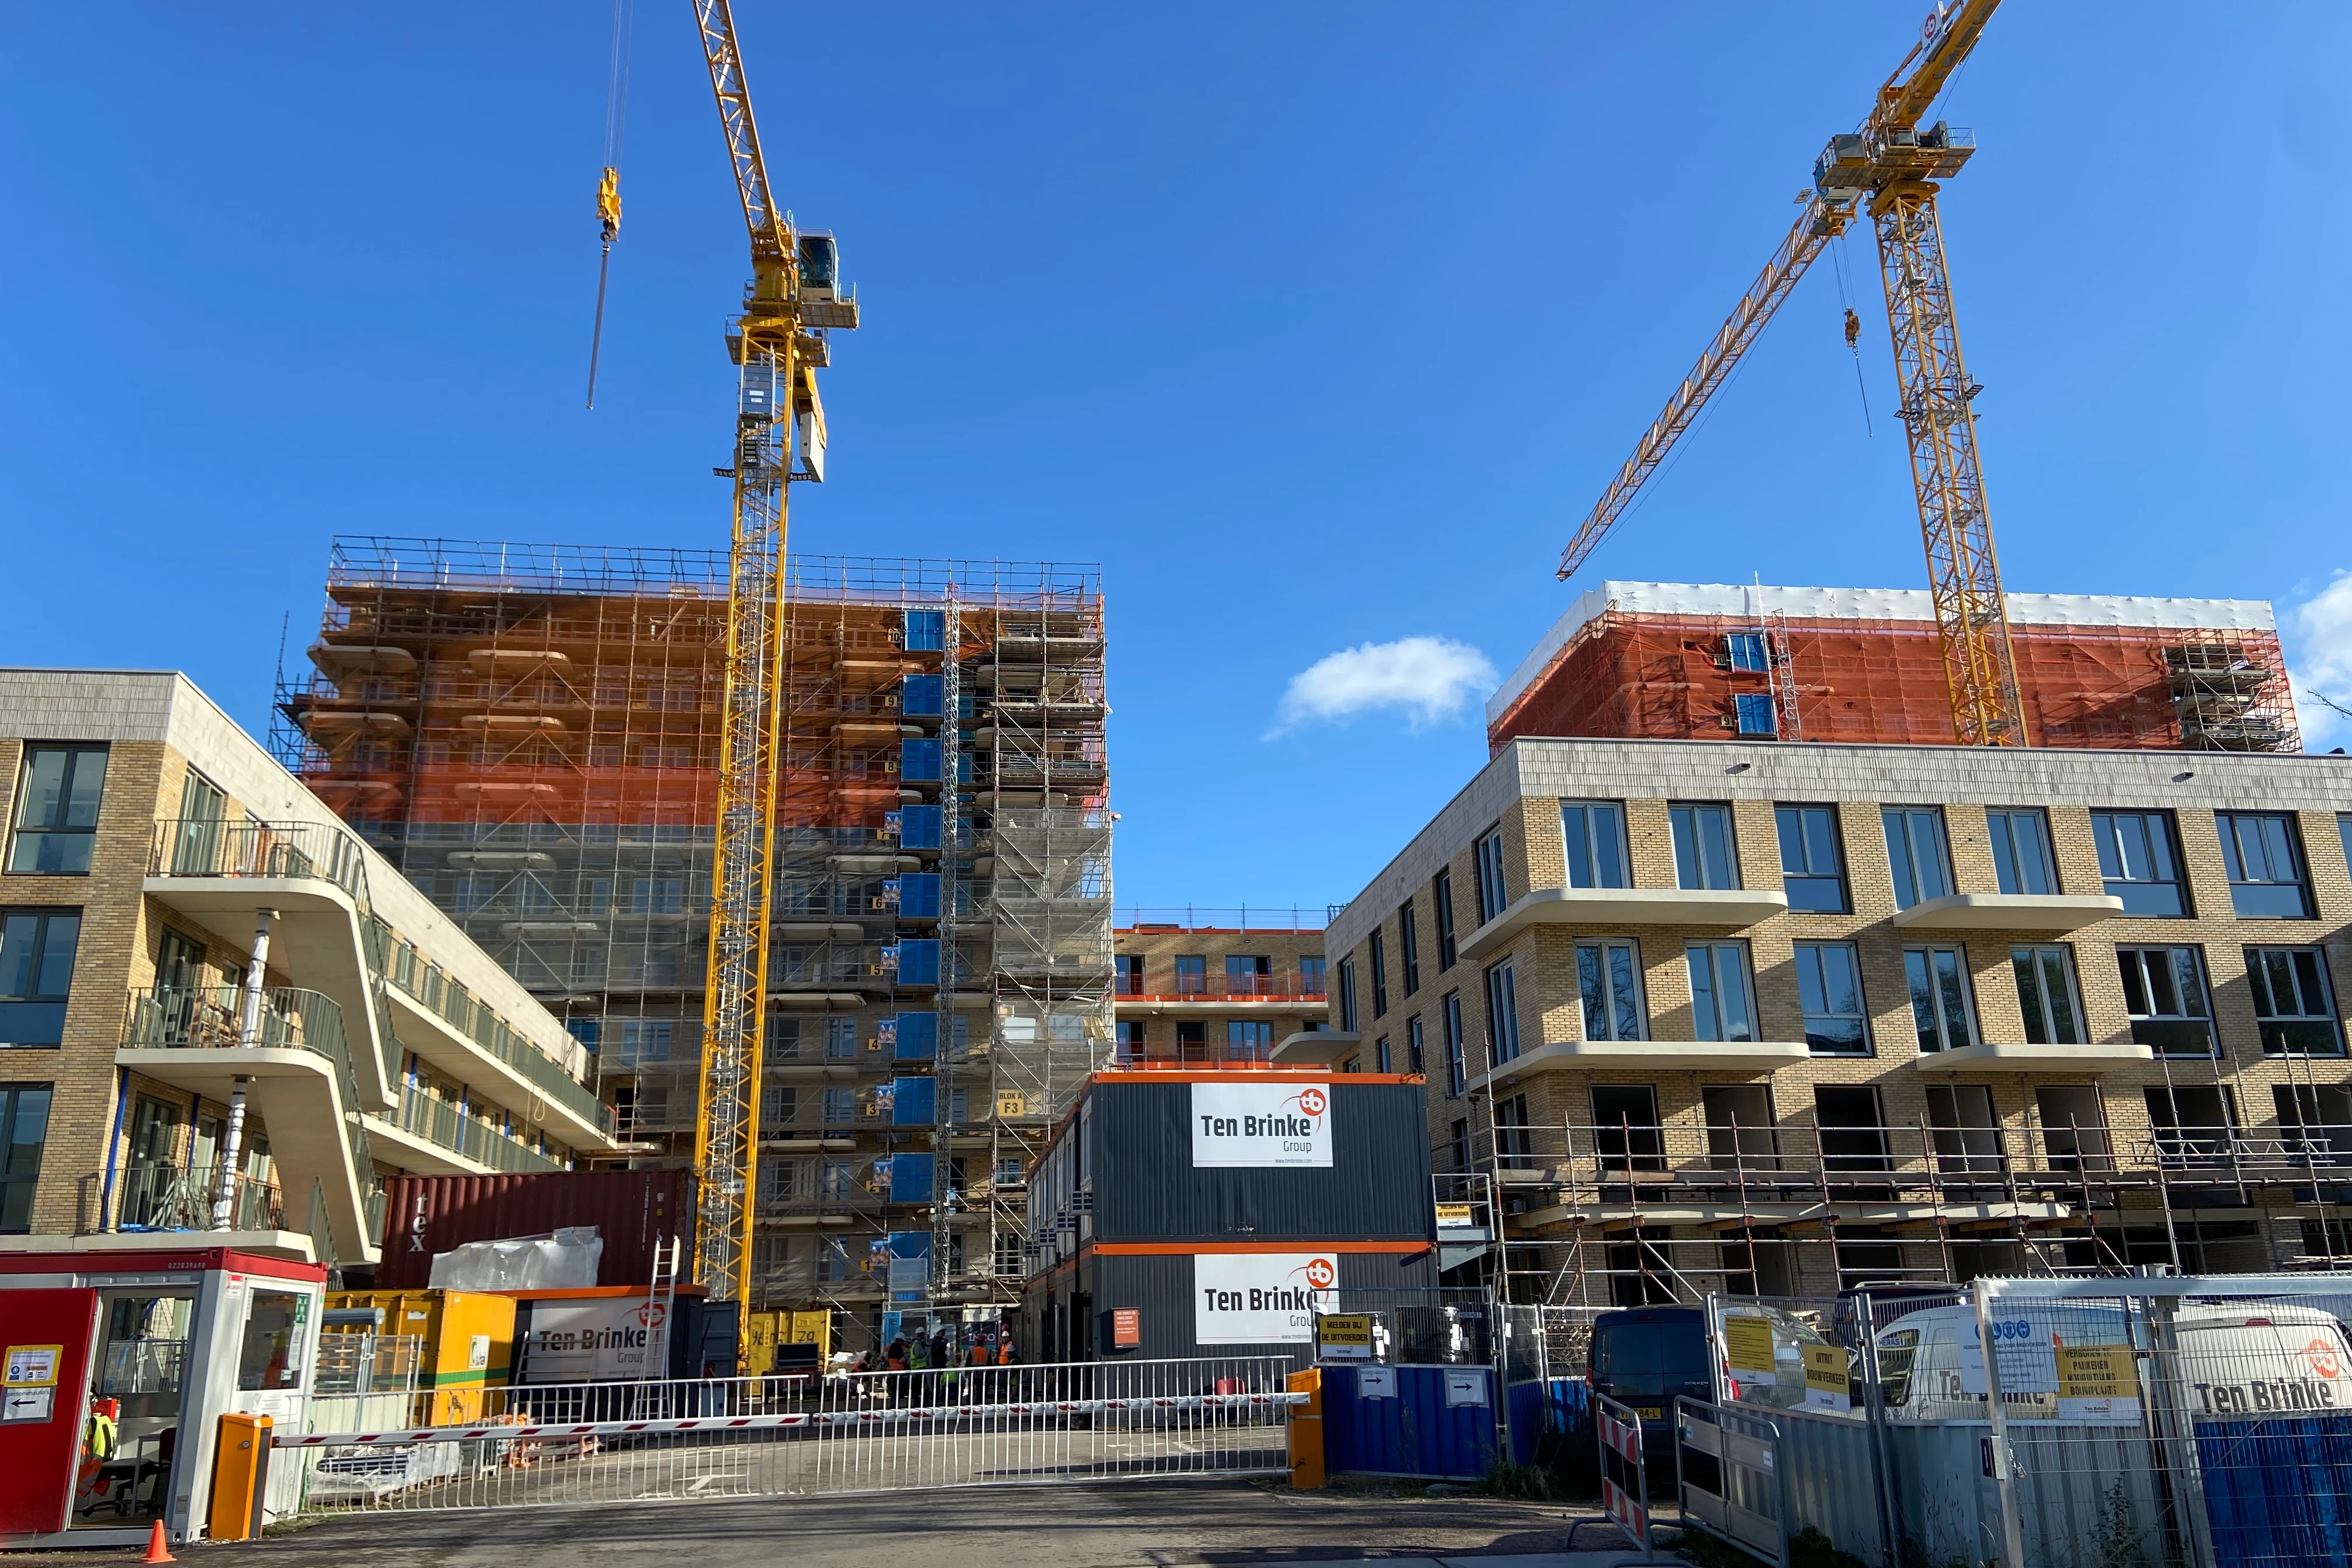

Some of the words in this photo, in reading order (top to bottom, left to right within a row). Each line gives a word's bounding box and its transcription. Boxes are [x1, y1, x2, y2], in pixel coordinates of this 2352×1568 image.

[888, 632, 900, 642] 10
[1715, 656, 1724, 664] 10
[888, 696, 894, 706] 9
[1724, 717, 1729, 725] 9
[888, 762, 894, 772] 8
[880, 830, 885, 839] 7
[876, 898, 882, 908] 6
[874, 965, 880, 975] 5
[872, 1039, 878, 1049] 4
[870, 1104, 876, 1115] 3
[1005, 1102, 1019, 1114] F3
[1200, 1115, 1238, 1136] Ten
[1244, 1113, 1311, 1136] Brinke
[1283, 1140, 1312, 1154] Group
[1204, 1288, 1242, 1311] Ten
[1290, 1315, 1312, 1326] Grou
[539, 1331, 575, 1351] Ten
[581, 1326, 647, 1350] Brinke
[1331, 1333, 1368, 1341] UITVOERDER
[2065, 1348, 2101, 1358] VERBODEN
[2102, 1348, 2112, 1357] TE
[1815, 1352, 1833, 1365] UITRIT
[2073, 1360, 2109, 1370] PARKEREN
[1807, 1368, 1846, 1386] BOUWVERKEER
[2070, 1385, 2117, 1395] BOUWPLAATS
[2194, 1382, 2248, 1414] Ten
[2250, 1376, 2334, 1411] Brinke
